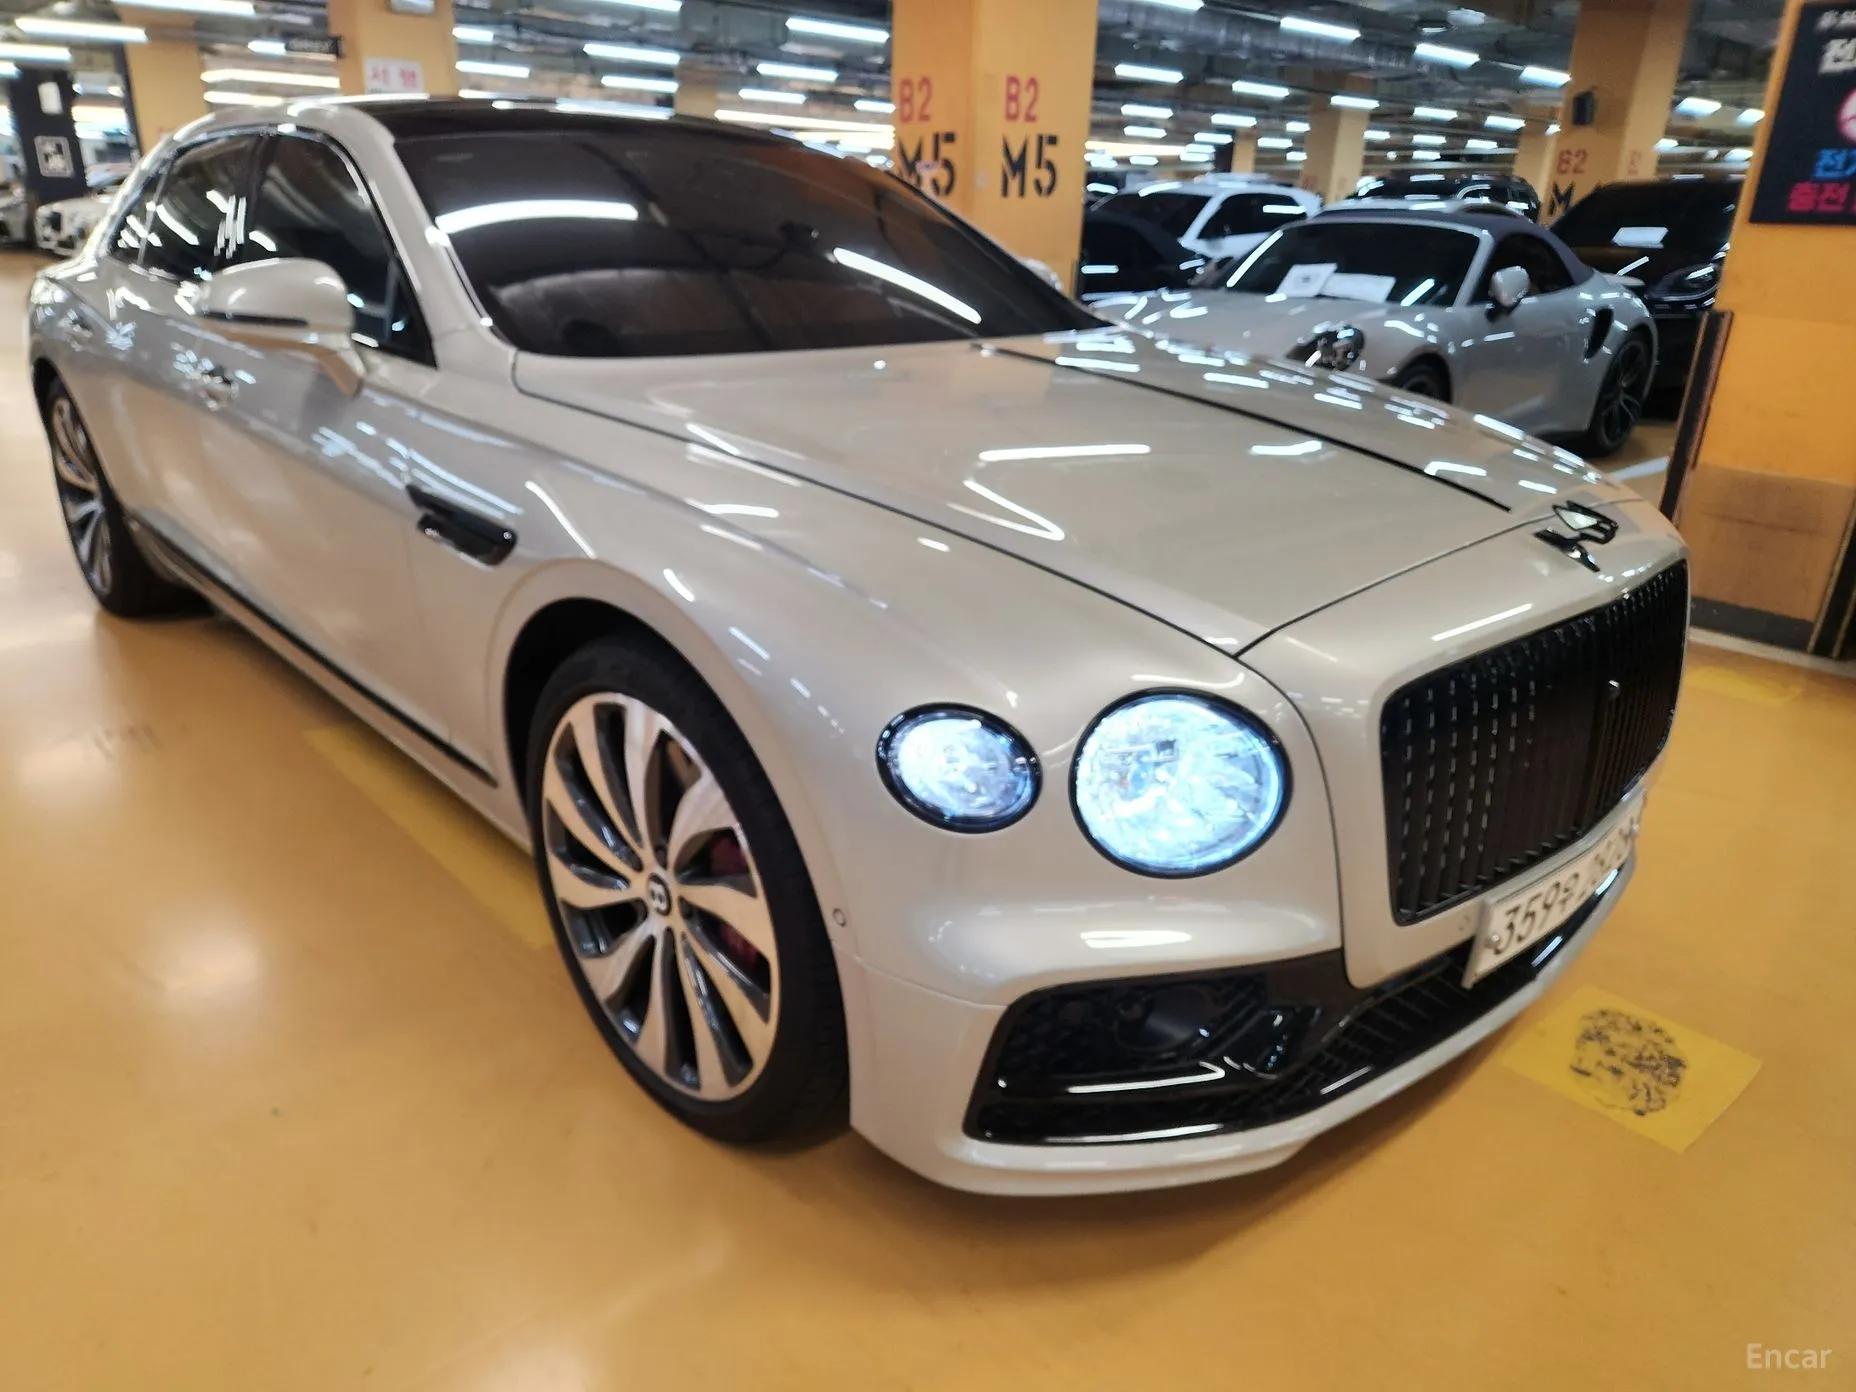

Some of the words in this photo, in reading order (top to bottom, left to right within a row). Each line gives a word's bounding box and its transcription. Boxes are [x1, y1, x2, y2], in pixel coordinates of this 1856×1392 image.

[900, 76, 932, 123] B2
[1005, 76, 1038, 122] B2
[899, 131, 956, 197] M5
[1001, 133, 1058, 198] M5
